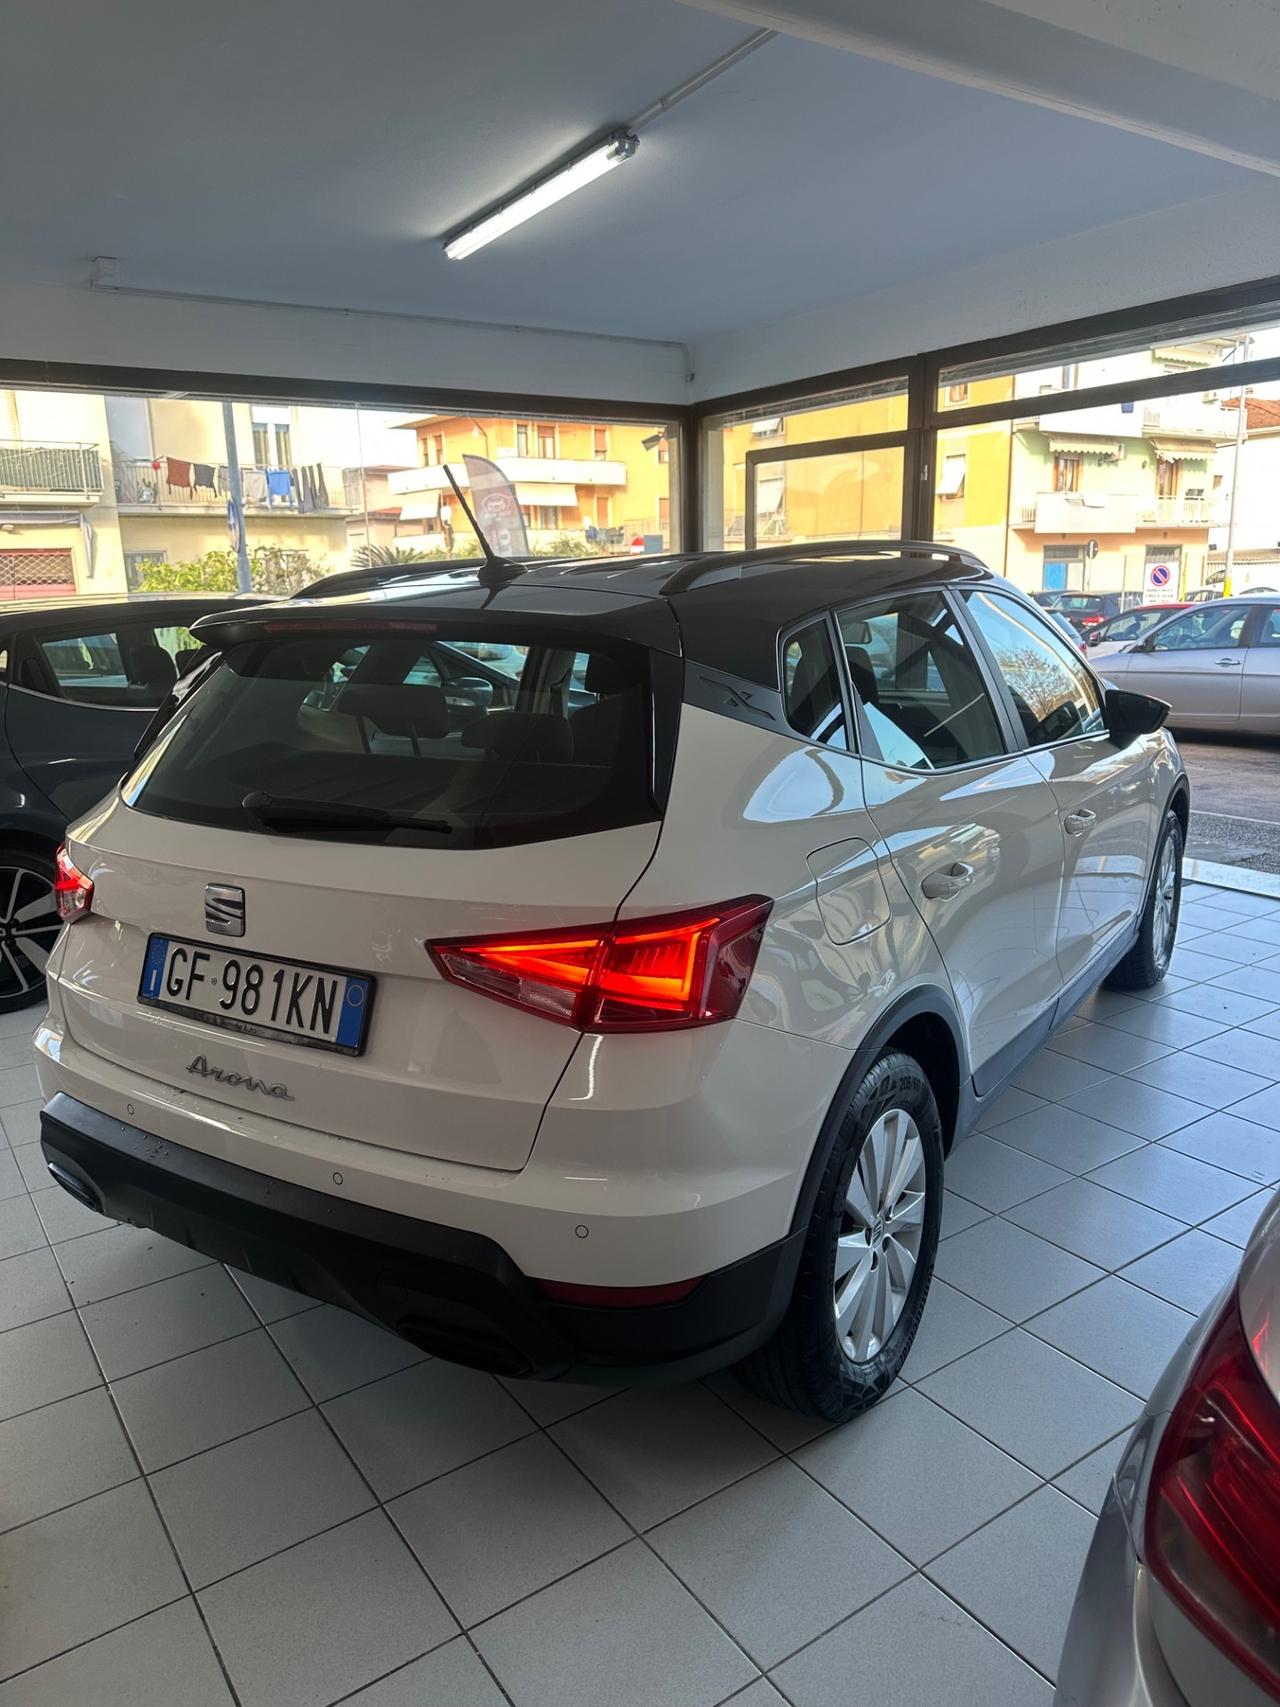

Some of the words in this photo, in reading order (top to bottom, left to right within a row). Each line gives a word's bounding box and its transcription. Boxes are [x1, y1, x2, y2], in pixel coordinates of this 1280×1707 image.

[149, 969, 157, 991] I
[166, 947, 210, 1000] GF
[219, 959, 338, 1034] 981KN
[185, 1054, 295, 1101] Arona
